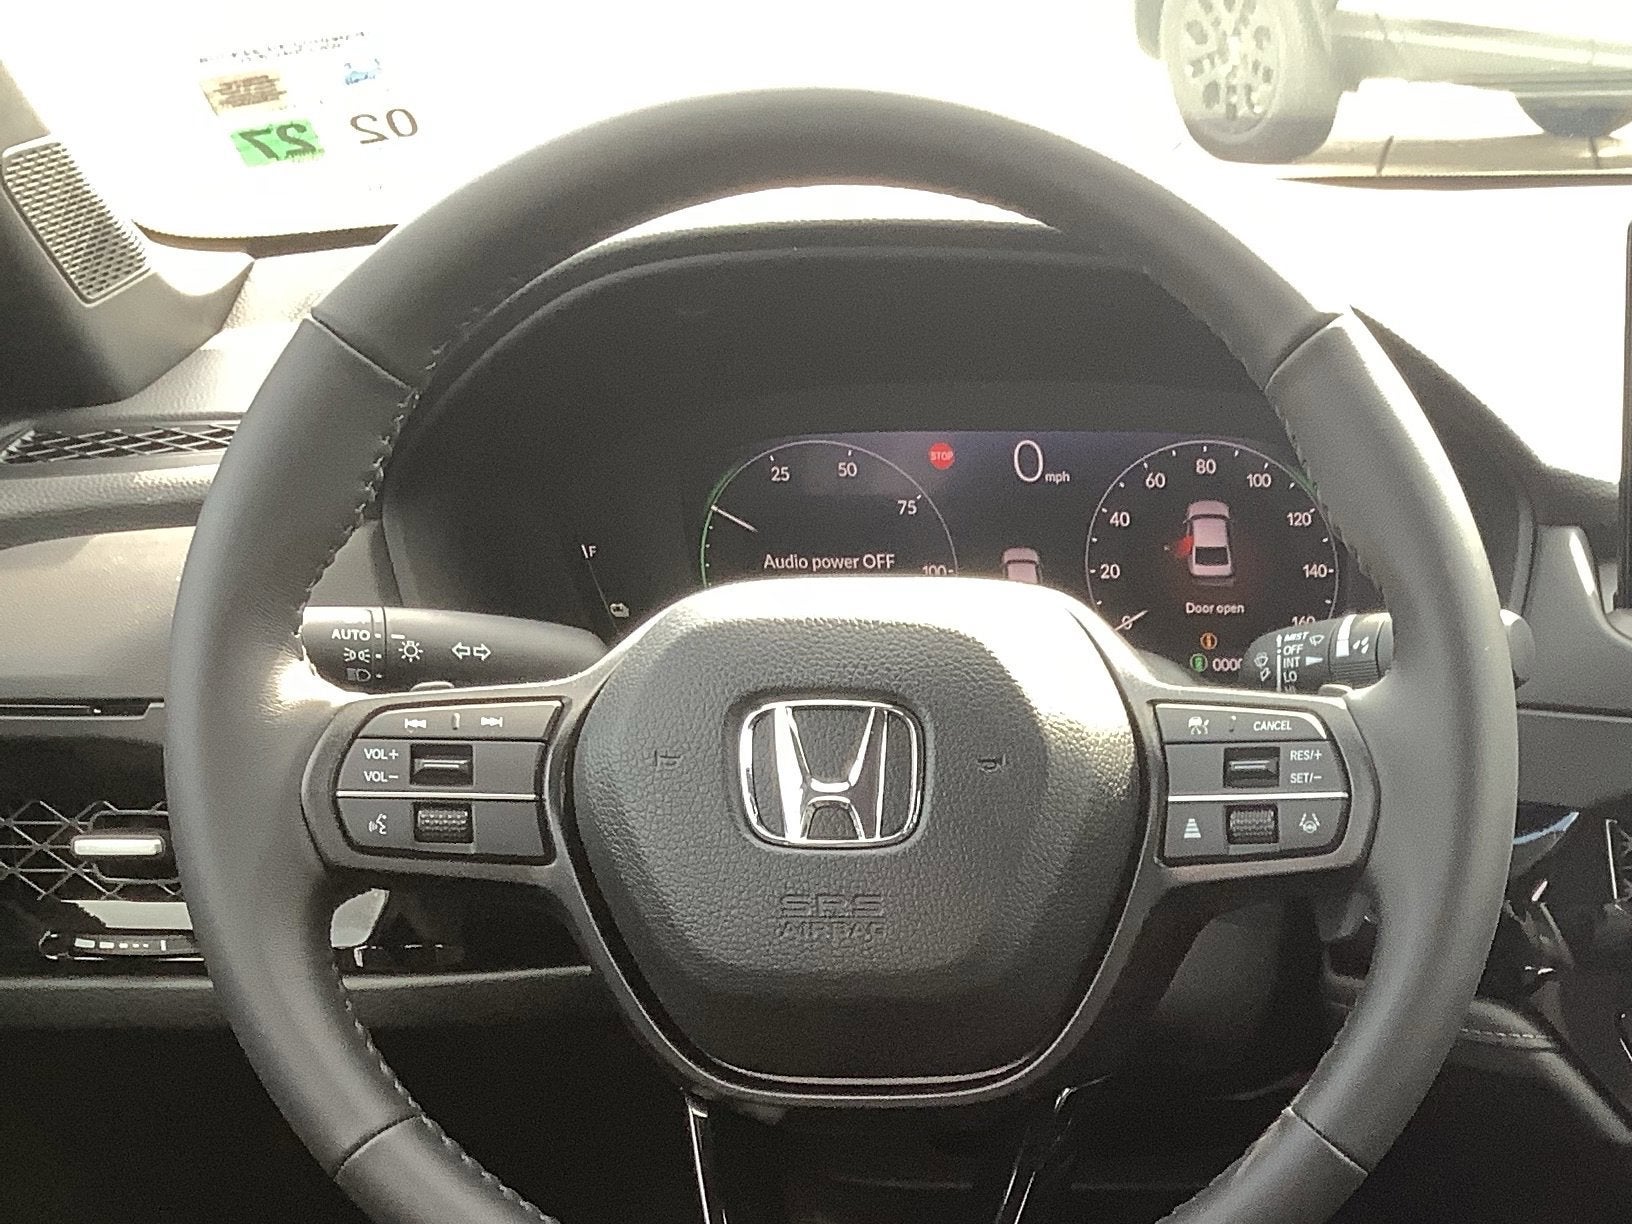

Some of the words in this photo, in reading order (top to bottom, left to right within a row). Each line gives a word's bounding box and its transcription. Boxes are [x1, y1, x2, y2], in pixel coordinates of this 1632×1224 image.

[930, 450, 954, 461] STOP
[1013, 440, 1044, 483] 0
[1045, 470, 1070, 484] mph
[770, 466, 790, 482] 25
[838, 462, 857, 478] 50
[1196, 459, 1216, 474] 80
[1145, 473, 1166, 489] 60
[1247, 473, 1272, 488] 100
[897, 500, 917, 515] 75
[1110, 512, 1131, 527] 40
[1287, 512, 1312, 526] 120
[763, 553, 808, 569] Audio
[812, 556, 859, 571] power
[863, 554, 895, 568] OFF
[1100, 564, 1120, 579] 20
[1303, 563, 1328, 578] 140
[1185, 602, 1215, 614] Door
[1216, 603, 1245, 616] open
[332, 629, 370, 641] AUTO
[1283, 644, 1303, 655] OFF
[1284, 656, 1300, 668] INT
[1283, 671, 1297, 683] LO
[1253, 720, 1292, 731] CANCEL
[1290, 750, 1322, 761] RES/+
[780, 892, 885, 916] SRS
